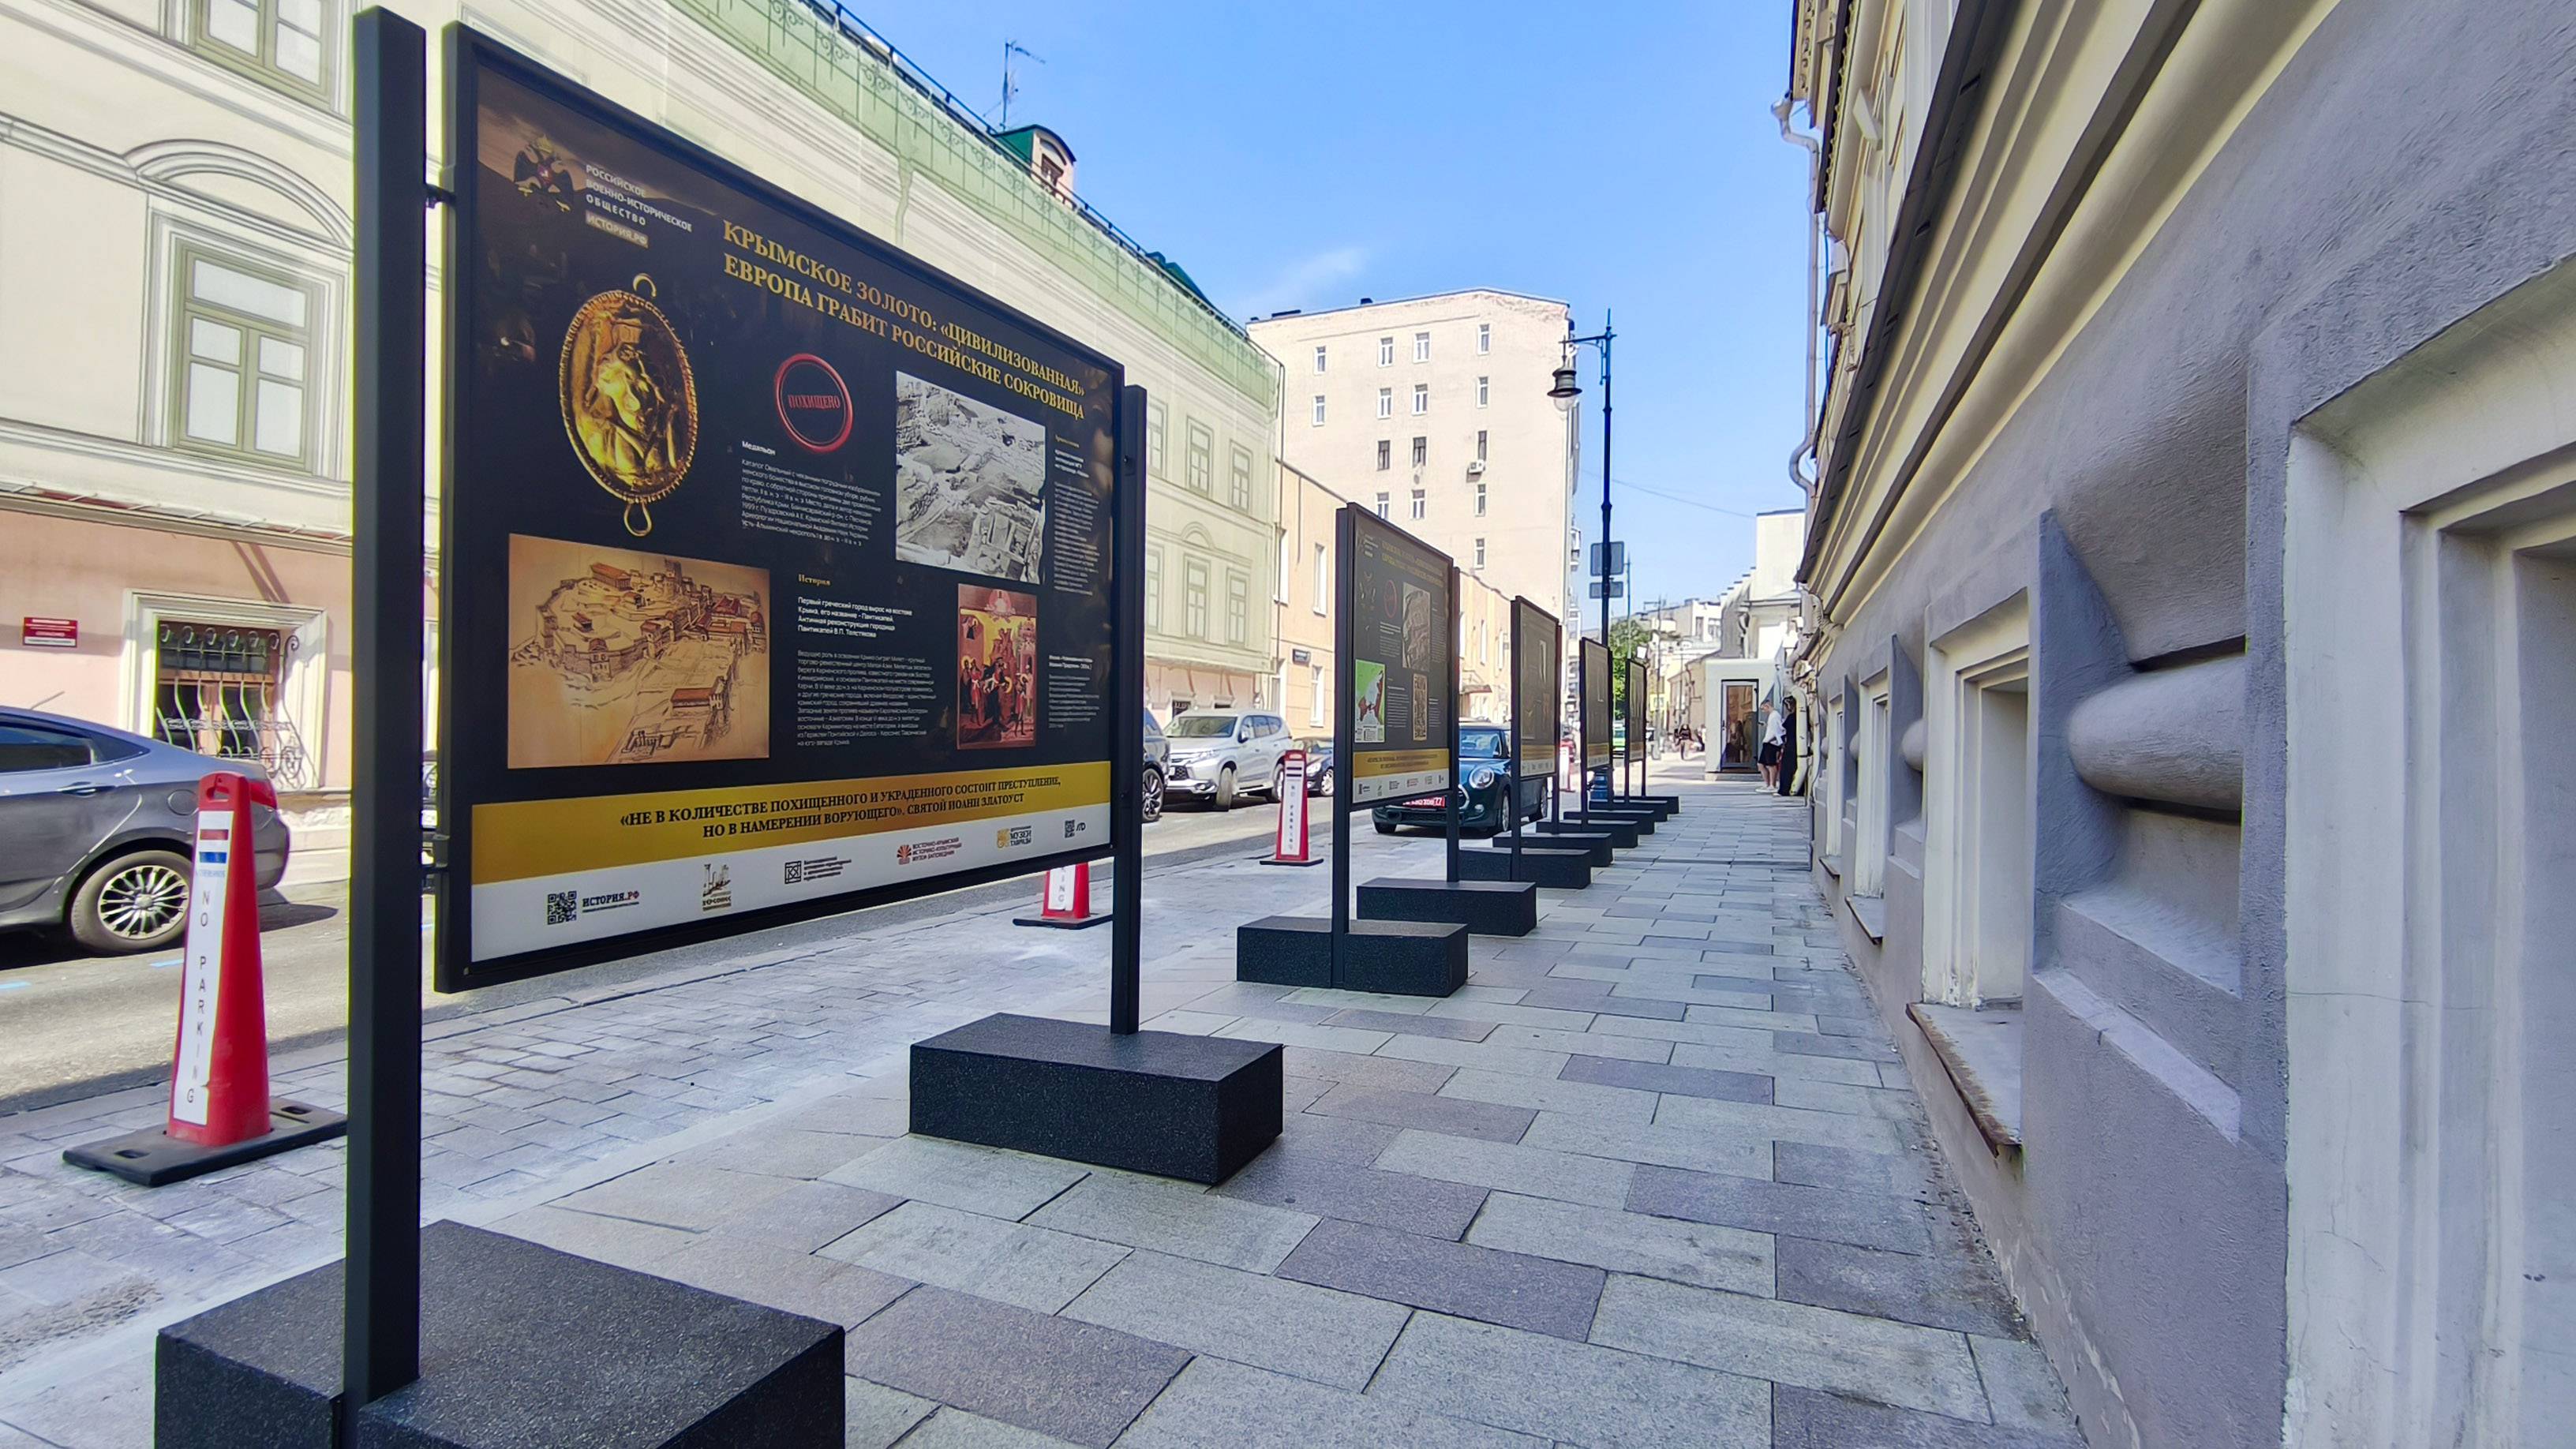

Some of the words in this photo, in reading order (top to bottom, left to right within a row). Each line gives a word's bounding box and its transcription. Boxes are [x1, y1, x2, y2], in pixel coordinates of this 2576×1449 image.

[586, 164, 646, 197] РОССИЙСКОЕ
[586, 179, 692, 233] ВОЕННО-ИСТОРИЧЕСКОЕ
[586, 194, 646, 226] ОБЩЕСТВО
[586, 213, 648, 245] ИСТОРИЯ.РФ
[723, 219, 852, 294] КРЫМСКОЕ
[856, 281, 937, 331] ЗОЛОТО:
[940, 322, 1086, 396] «ЦИВИЛИЗОВАННАЯ»
[724, 253, 814, 308] ЕВРОПА
[817, 292, 888, 337] ГРАБИТ
[892, 324, 1002, 385] РОССИЙСКИЕ
[1004, 373, 1084, 421] СОКРОВИЩА
[620, 811, 651, 826] «НЕ
[656, 811, 665, 823] В
[669, 801, 767, 822] КОЛИЧЕСТВЕ
[770, 793, 867, 812] ПОХИЩЕННОГО
[870, 792, 879, 803] И
[880, 785, 953, 803] УКРАДЕННОГО
[955, 782, 997, 795] СОСТОИТ
[998, 777, 1061, 791] ПРЕСТУПЛЕНИЕ,
[702, 824, 724, 837] НО
[728, 823, 736, 835] В
[740, 814, 822, 834] НАМЕРЕНИИ
[826, 806, 905, 824] ВОРУЮЩЕГО».
[908, 798, 946, 814] СВЯТОЙ
[949, 798, 980, 810] ИОАНН
[981, 792, 1024, 807] ЗЛАТОУСТ
[200, 890, 210, 927] NO
[582, 891, 639, 907] ИСТОРИЯ.РФ
